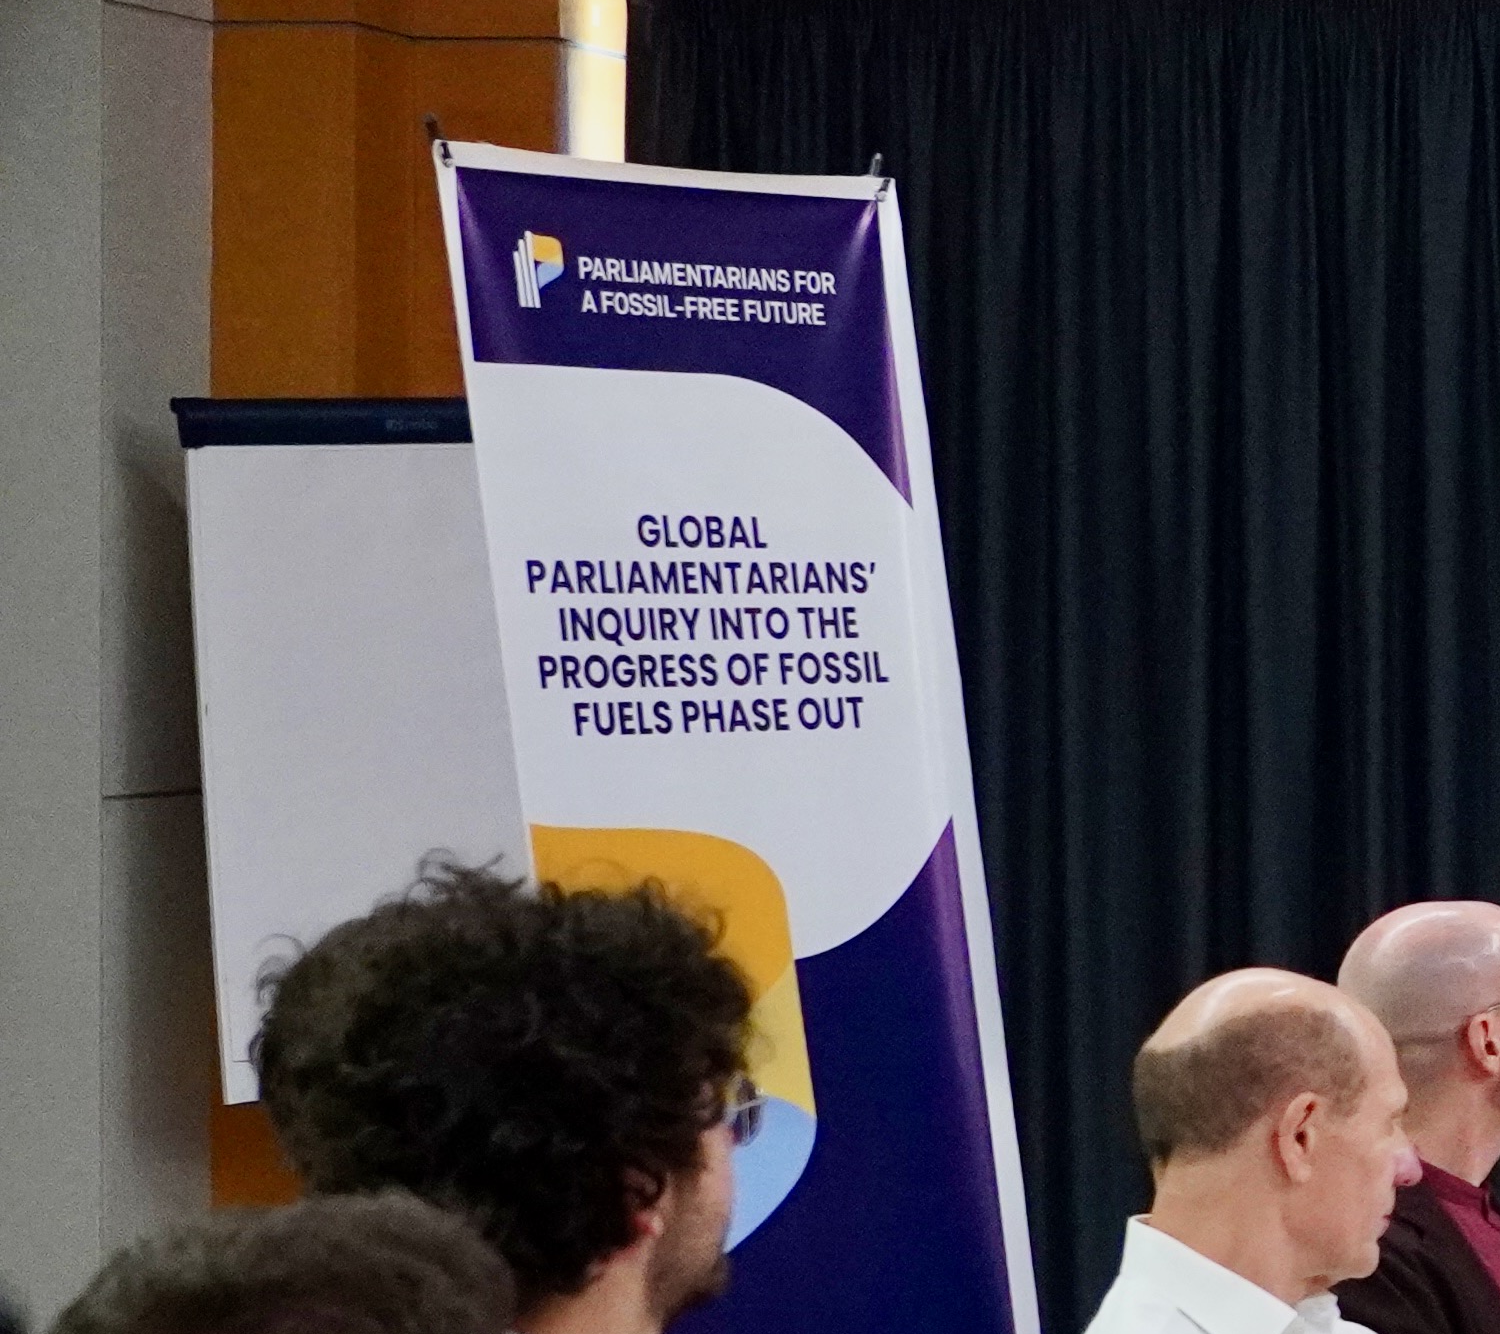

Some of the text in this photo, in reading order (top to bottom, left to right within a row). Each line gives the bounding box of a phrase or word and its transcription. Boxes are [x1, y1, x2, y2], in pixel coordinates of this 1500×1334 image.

[578, 257, 837, 295] PARLIAMENTARIANS FOR
[580, 290, 826, 326] A FOSSIL-FREE FUTURE
[637, 514, 768, 549] GLOBAL
[559, 606, 859, 646] INQUIRY INTO THE
[538, 651, 889, 690] PROGRESS OF FOSSIL
[573, 696, 864, 737] FUELS PHASE OUT
